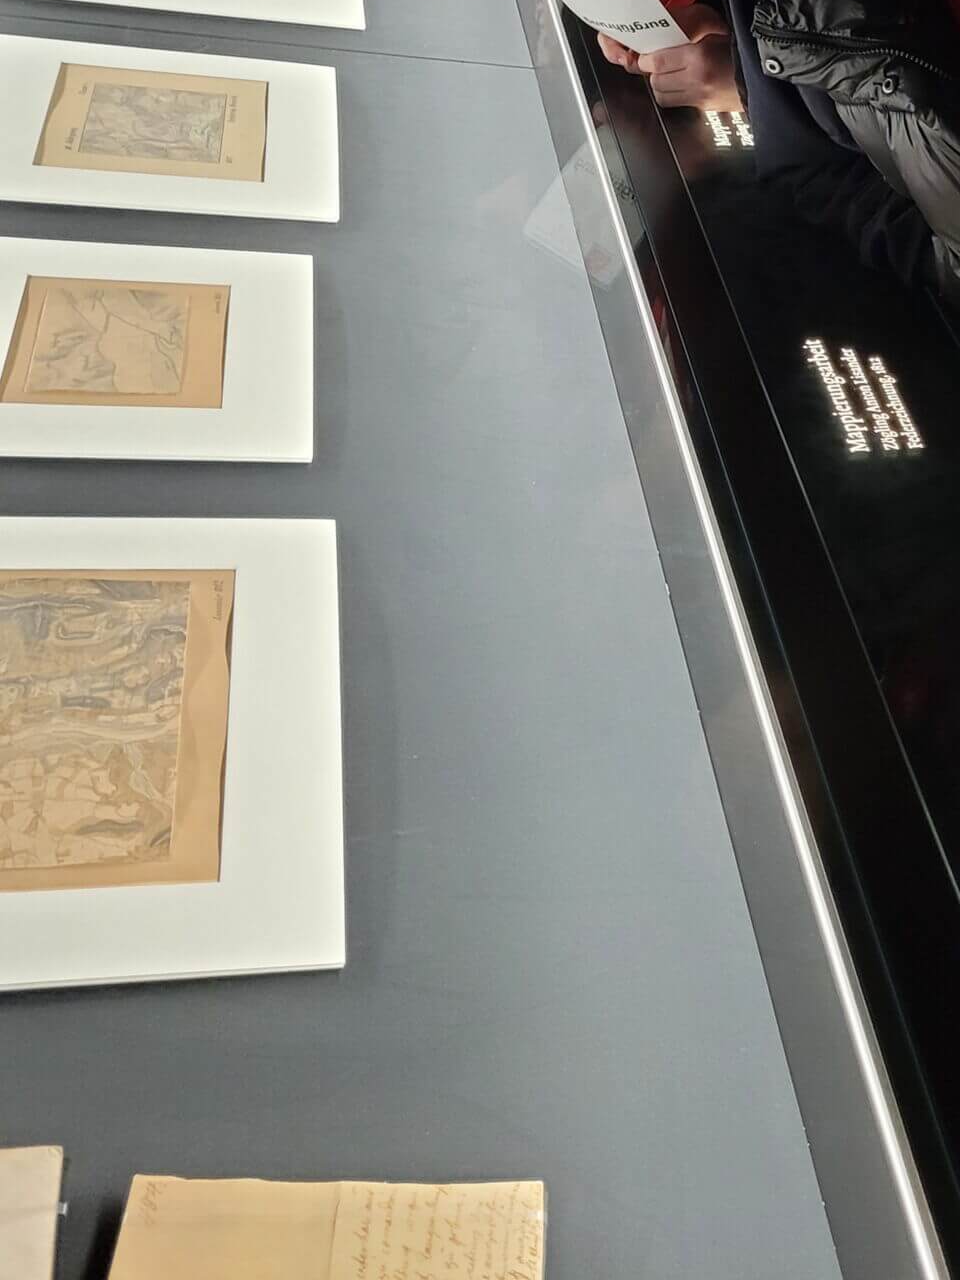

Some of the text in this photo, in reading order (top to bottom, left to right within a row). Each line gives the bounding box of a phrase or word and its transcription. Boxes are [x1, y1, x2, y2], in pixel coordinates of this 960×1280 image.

[802, 339, 871, 454] Mappierungsarbeit
[860, 384, 882, 413] Anton
[872, 412, 900, 451] Zögling
